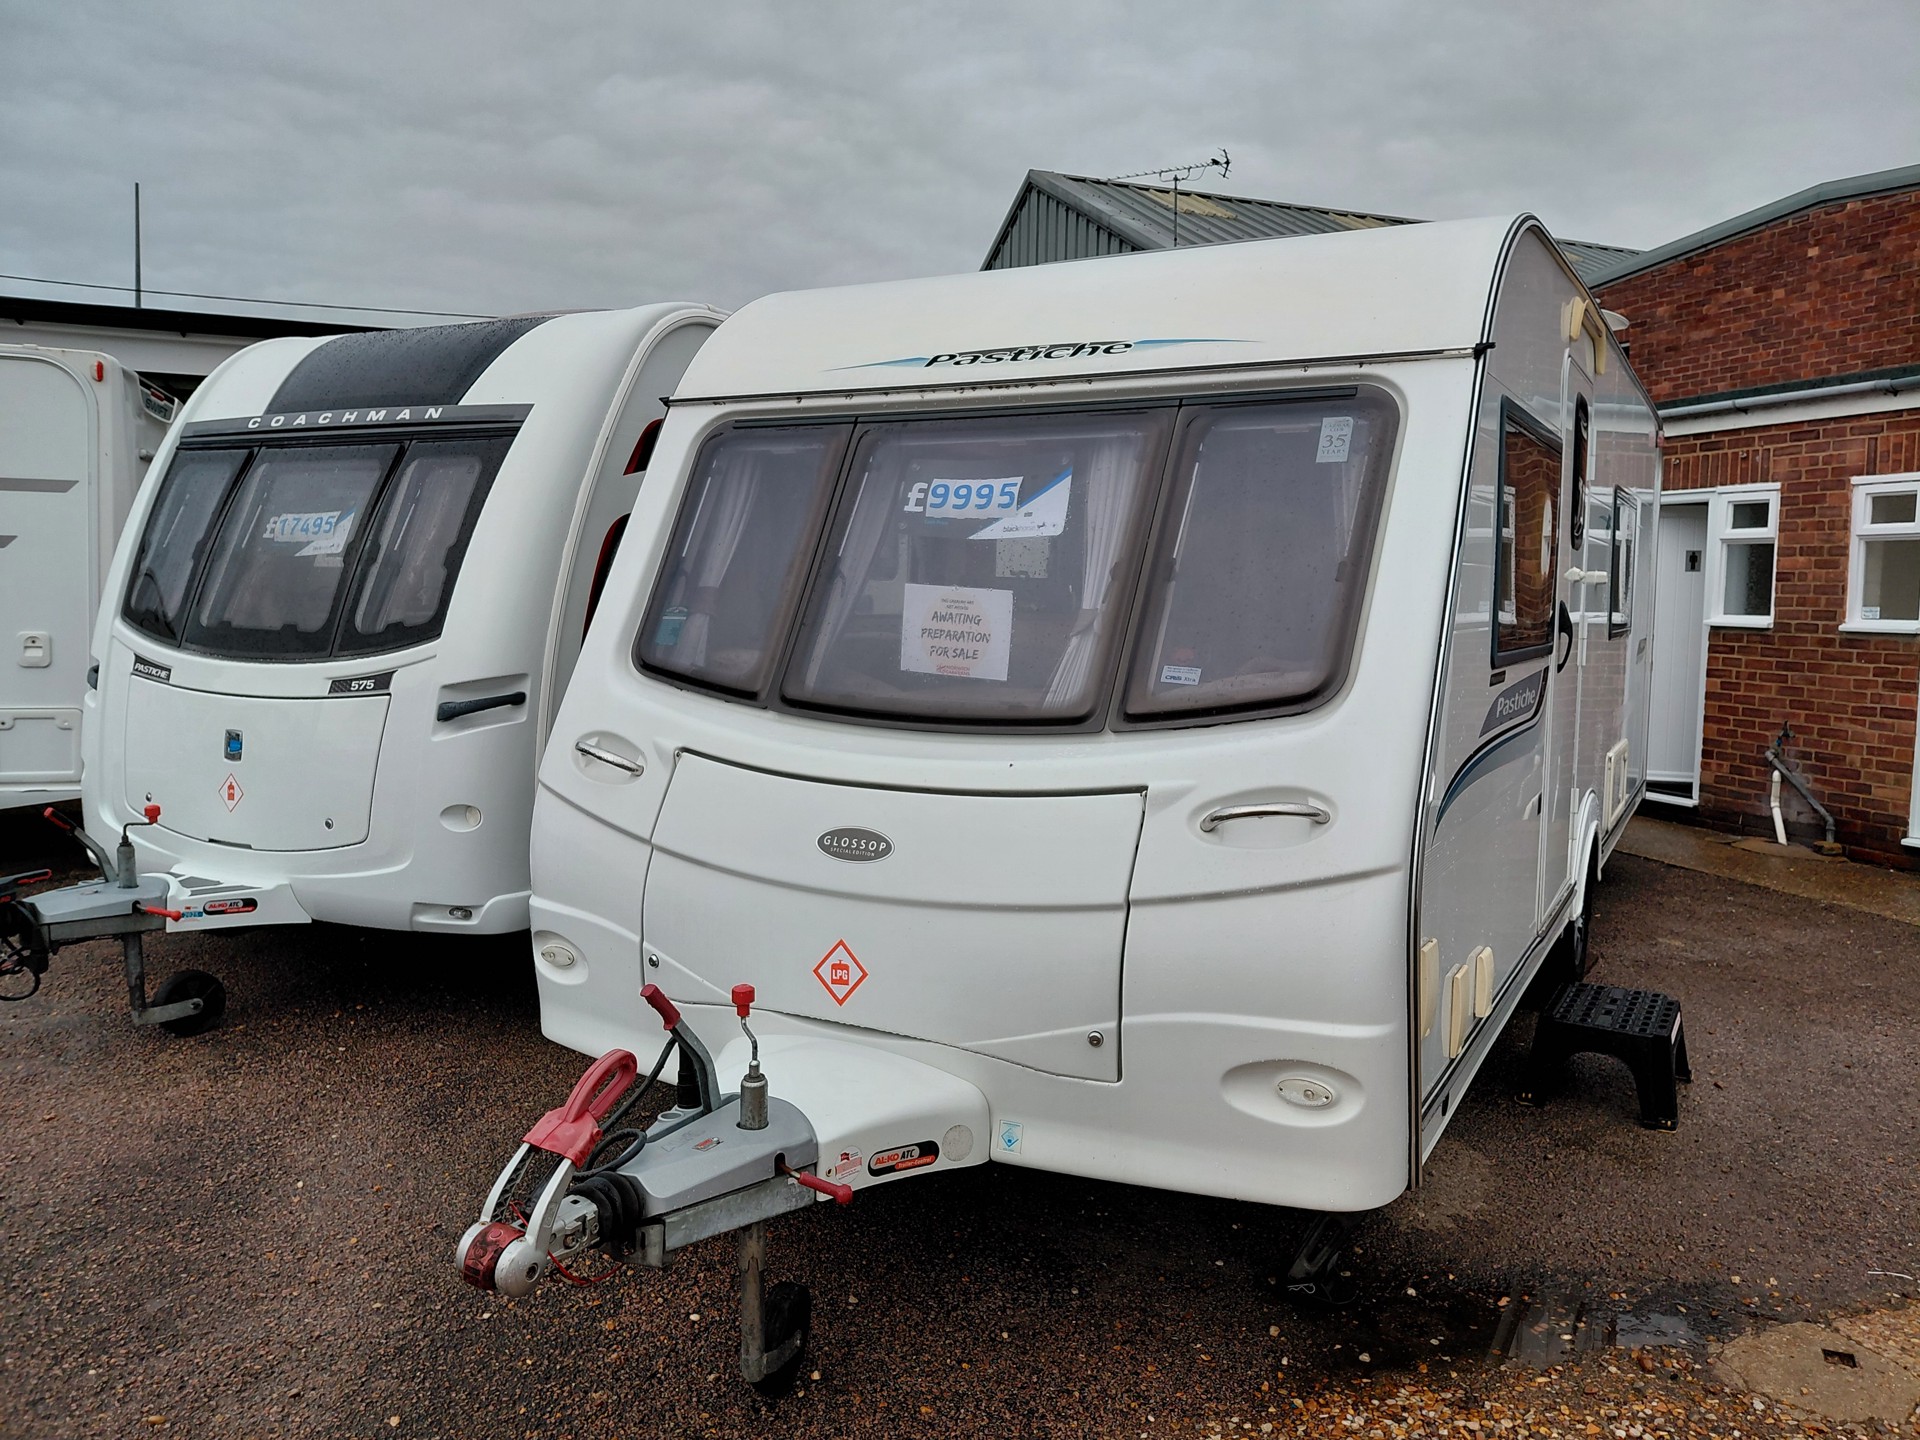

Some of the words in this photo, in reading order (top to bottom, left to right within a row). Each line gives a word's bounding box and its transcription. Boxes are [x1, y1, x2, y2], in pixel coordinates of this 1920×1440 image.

[924, 342, 1134, 368] Pastiche
[247, 407, 443, 429] COACHMAN
[1322, 433, 1348, 448] 35
[903, 481, 1019, 512] £9995
[262, 515, 337, 538] £17495
[931, 610, 982, 626] AWAITING
[921, 627, 991, 643] PREPARATION
[929, 645, 950, 659] FOR
[951, 647, 979, 660] SALE
[134, 662, 170, 679] PASTICHE
[350, 679, 376, 691] 575
[1496, 686, 1536, 718] Pastiche
[823, 835, 887, 852] GLOSSOP
[852, 849, 875, 857] EDITION
[832, 969, 848, 980] LPG
[900, 1148, 916, 1160] ATC
